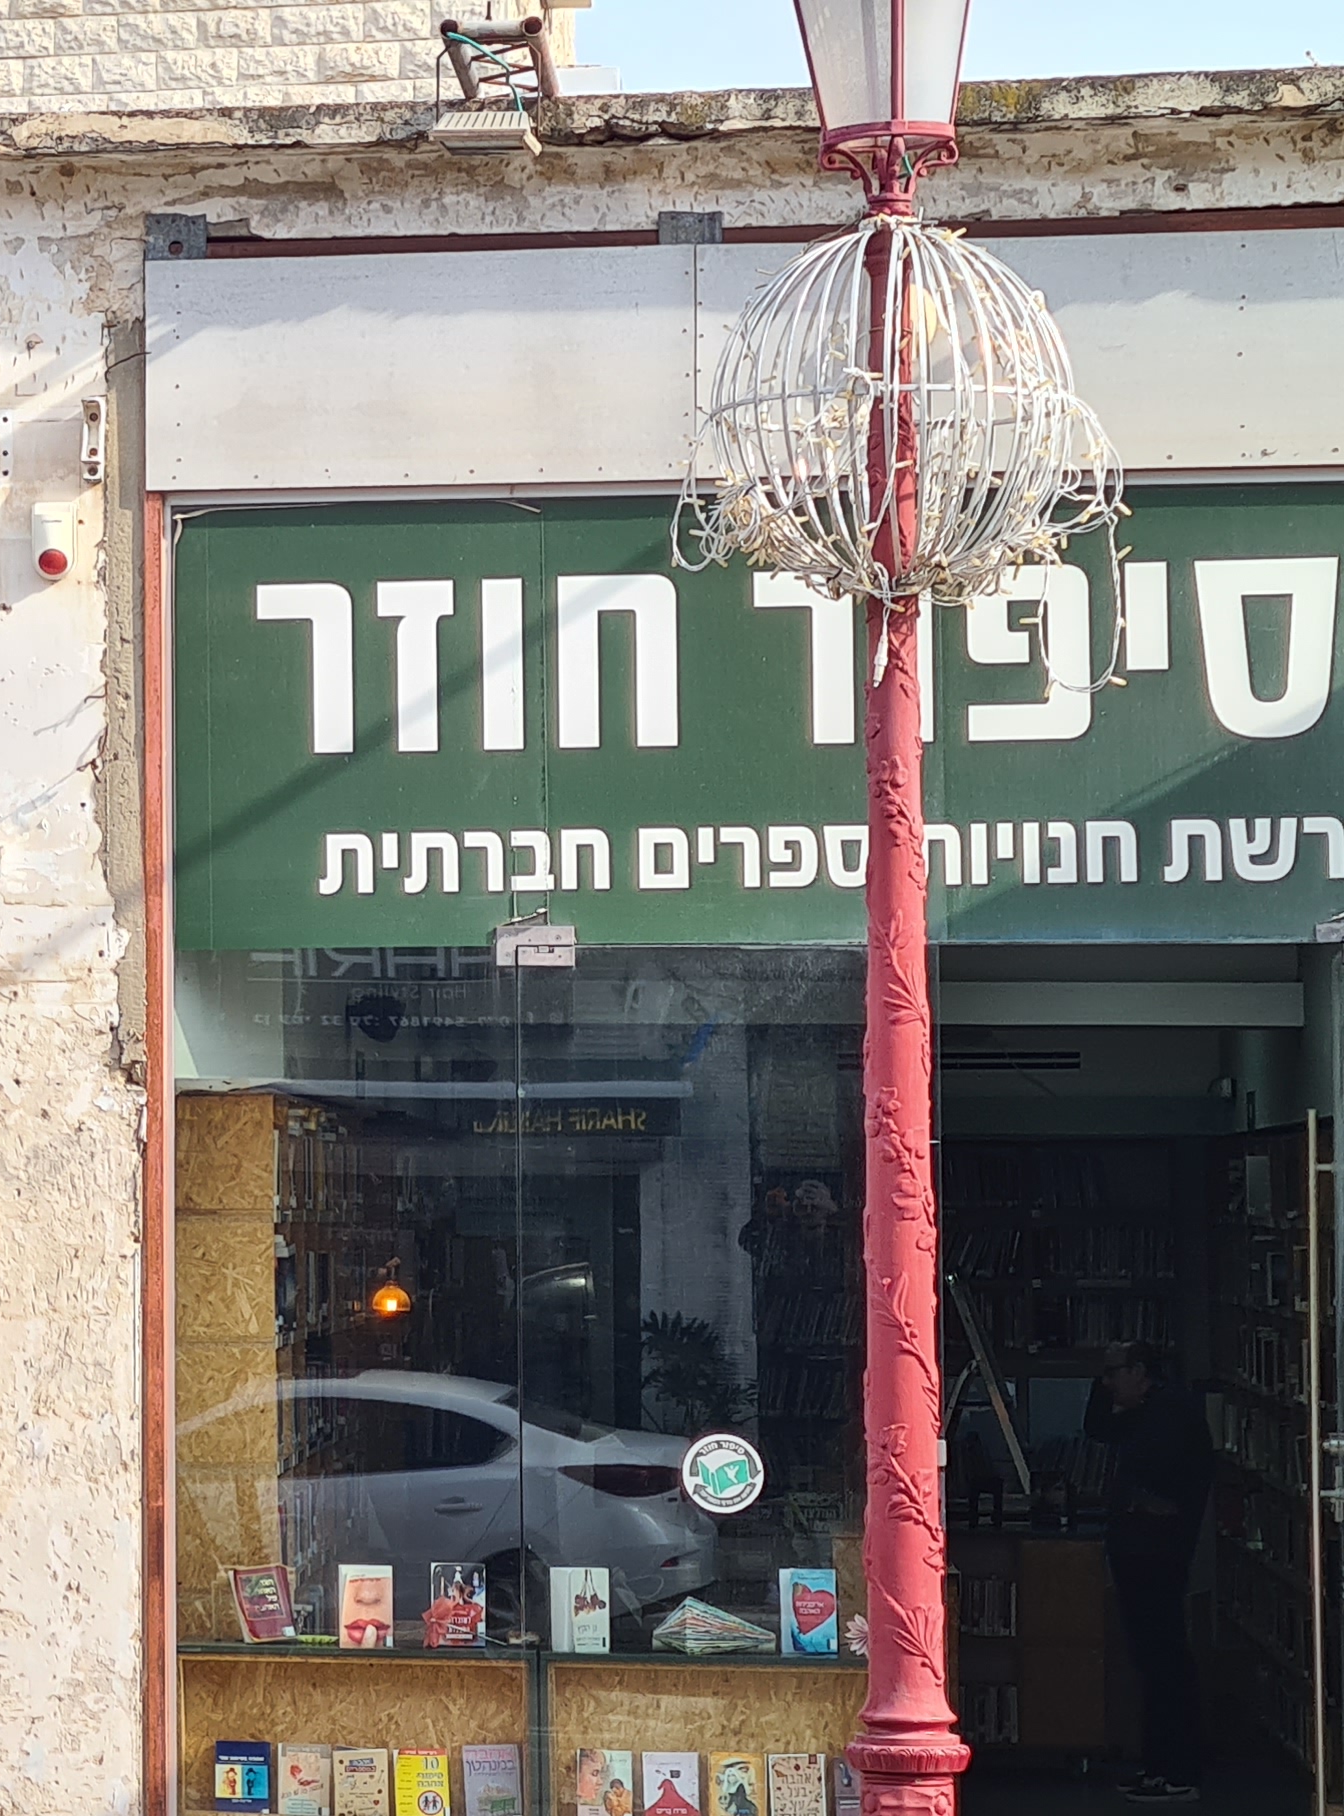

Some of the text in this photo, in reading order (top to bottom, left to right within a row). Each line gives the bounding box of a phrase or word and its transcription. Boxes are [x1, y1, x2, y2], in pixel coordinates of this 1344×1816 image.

[255, 574, 679, 755] חוזר
[638, 825, 869, 889] ספרים
[1163, 816, 1344, 883] רשת
[317, 828, 611, 896] חברתית
[698, 1441, 746, 1456] סיפור חוזר
[465, 1748, 515, 1760] אהבה
[423, 1756, 440, 1770] 10
[465, 1760, 517, 1776] במנהטן
[781, 1772, 812, 1784] אהבה
